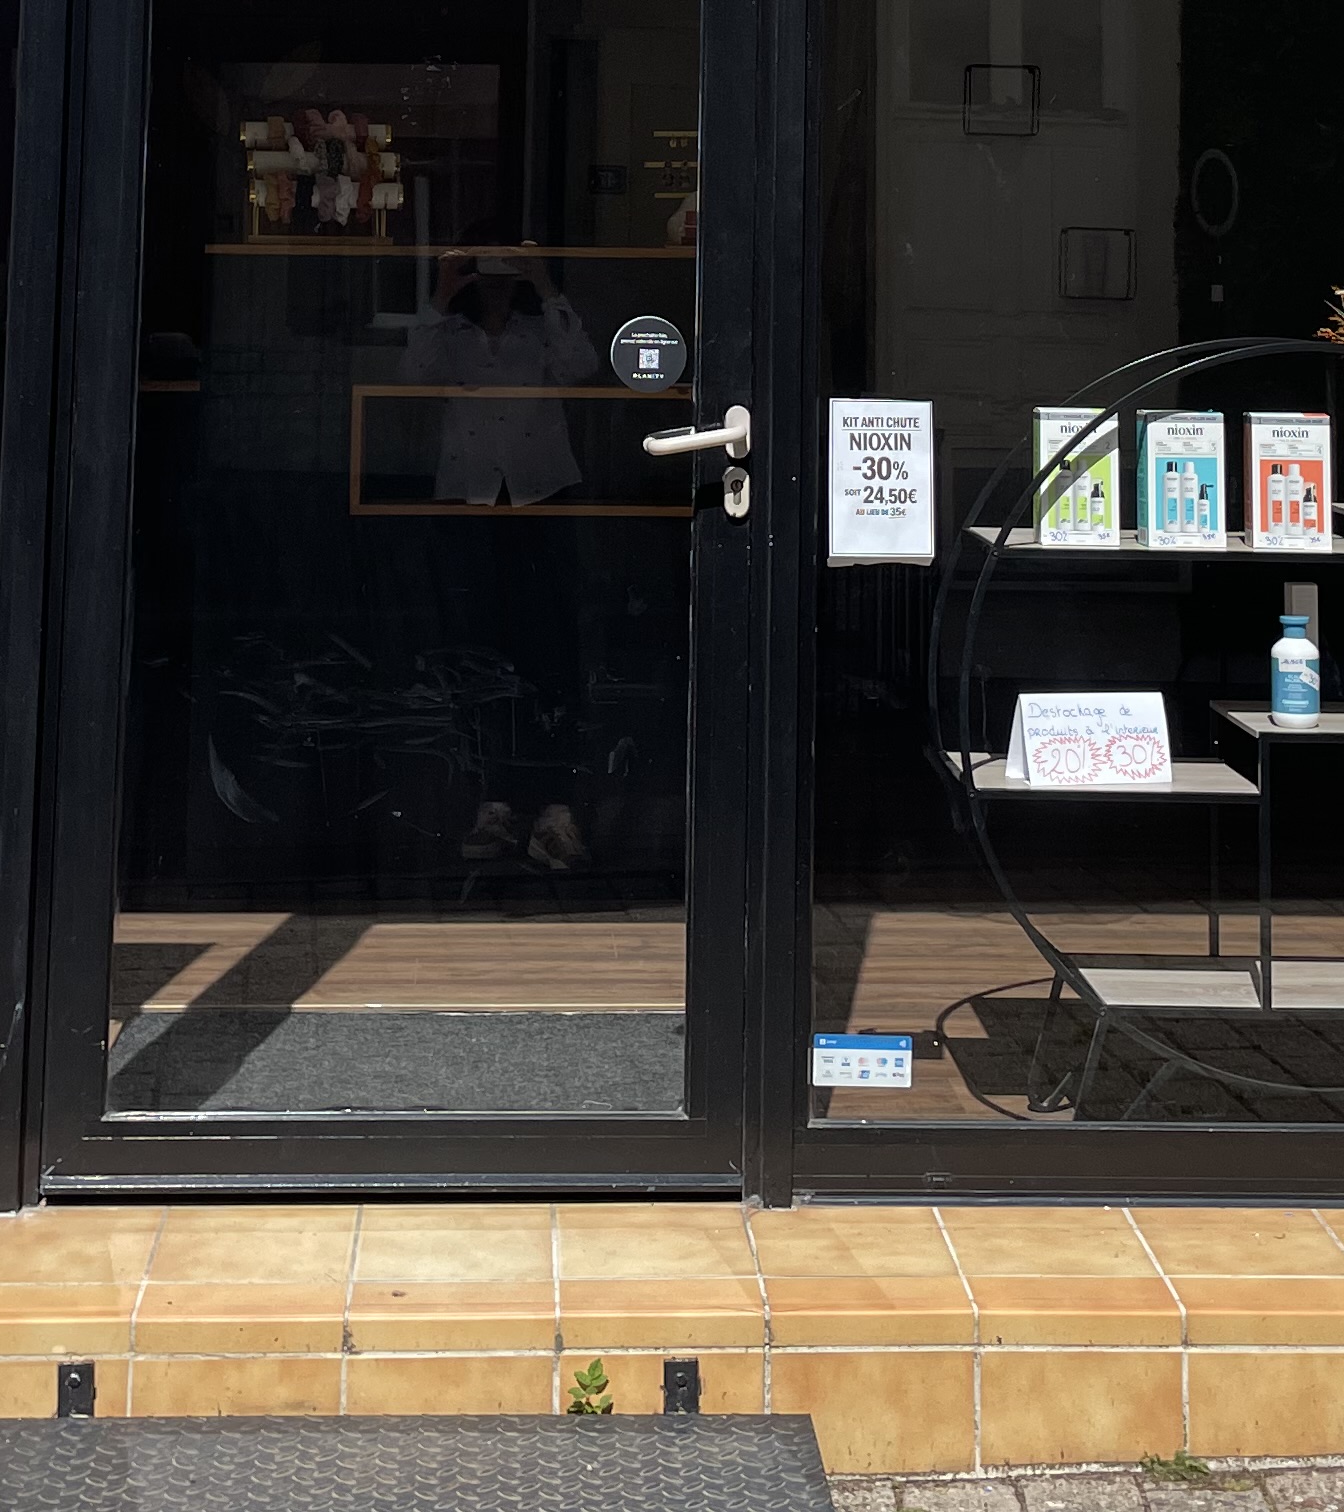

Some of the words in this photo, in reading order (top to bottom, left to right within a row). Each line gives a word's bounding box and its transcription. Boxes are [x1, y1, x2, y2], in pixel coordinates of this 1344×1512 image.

[843, 416, 859, 428] KIT
[861, 416, 884, 428] ANTI
[886, 417, 920, 428] CHUTE
[1167, 424, 1204, 436] nioxin
[1272, 427, 1309, 438] nioxin
[849, 432, 911, 451] NIOXIN
[853, 456, 909, 481] -30%
[844, 488, 861, 496] SOIT
[863, 485, 917, 505] 24,50€
[1119, 703, 1133, 716] de
[1027, 725, 1079, 739] produits
[1085, 726, 1094, 736] à
